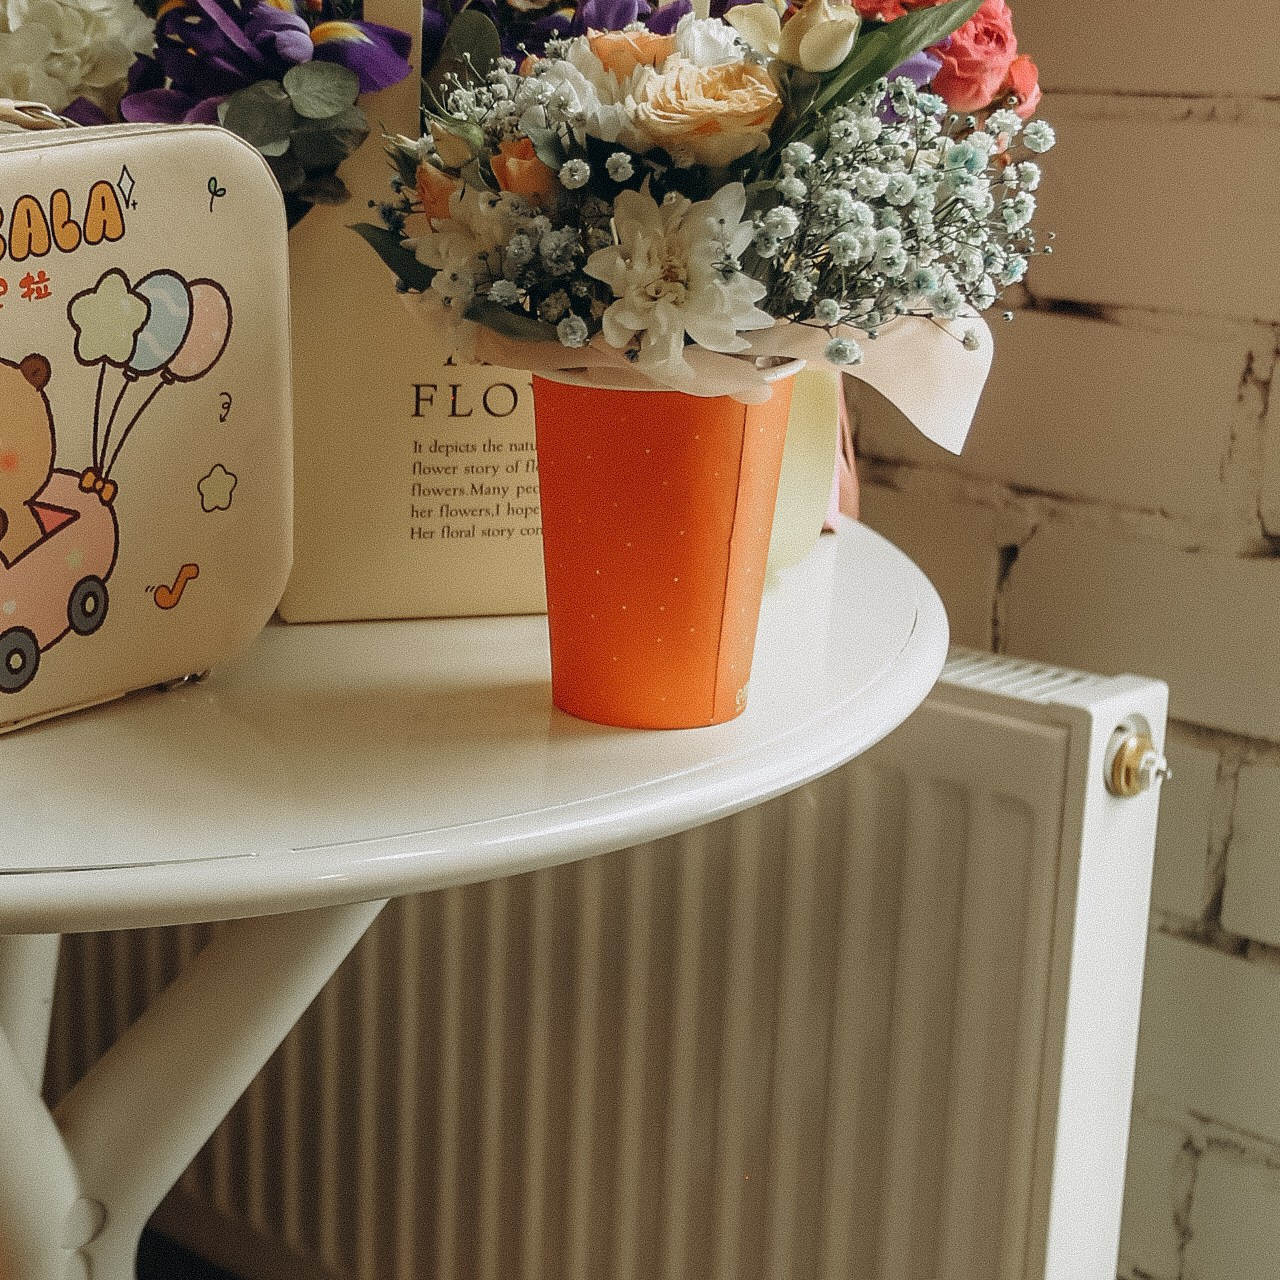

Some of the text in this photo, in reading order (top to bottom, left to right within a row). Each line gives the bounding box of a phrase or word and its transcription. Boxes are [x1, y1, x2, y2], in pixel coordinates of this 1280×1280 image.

[411, 382, 533, 418] FLO
[413, 440, 423, 454] It
[428, 439, 478, 458] depicts
[482, 439, 504, 453] the
[412, 459, 539, 478] flower story of fl
[410, 504, 434, 518] her
[506, 502, 541, 519] hope
[410, 526, 436, 540] Her
[441, 524, 477, 539] floral
[481, 527, 516, 540] story
